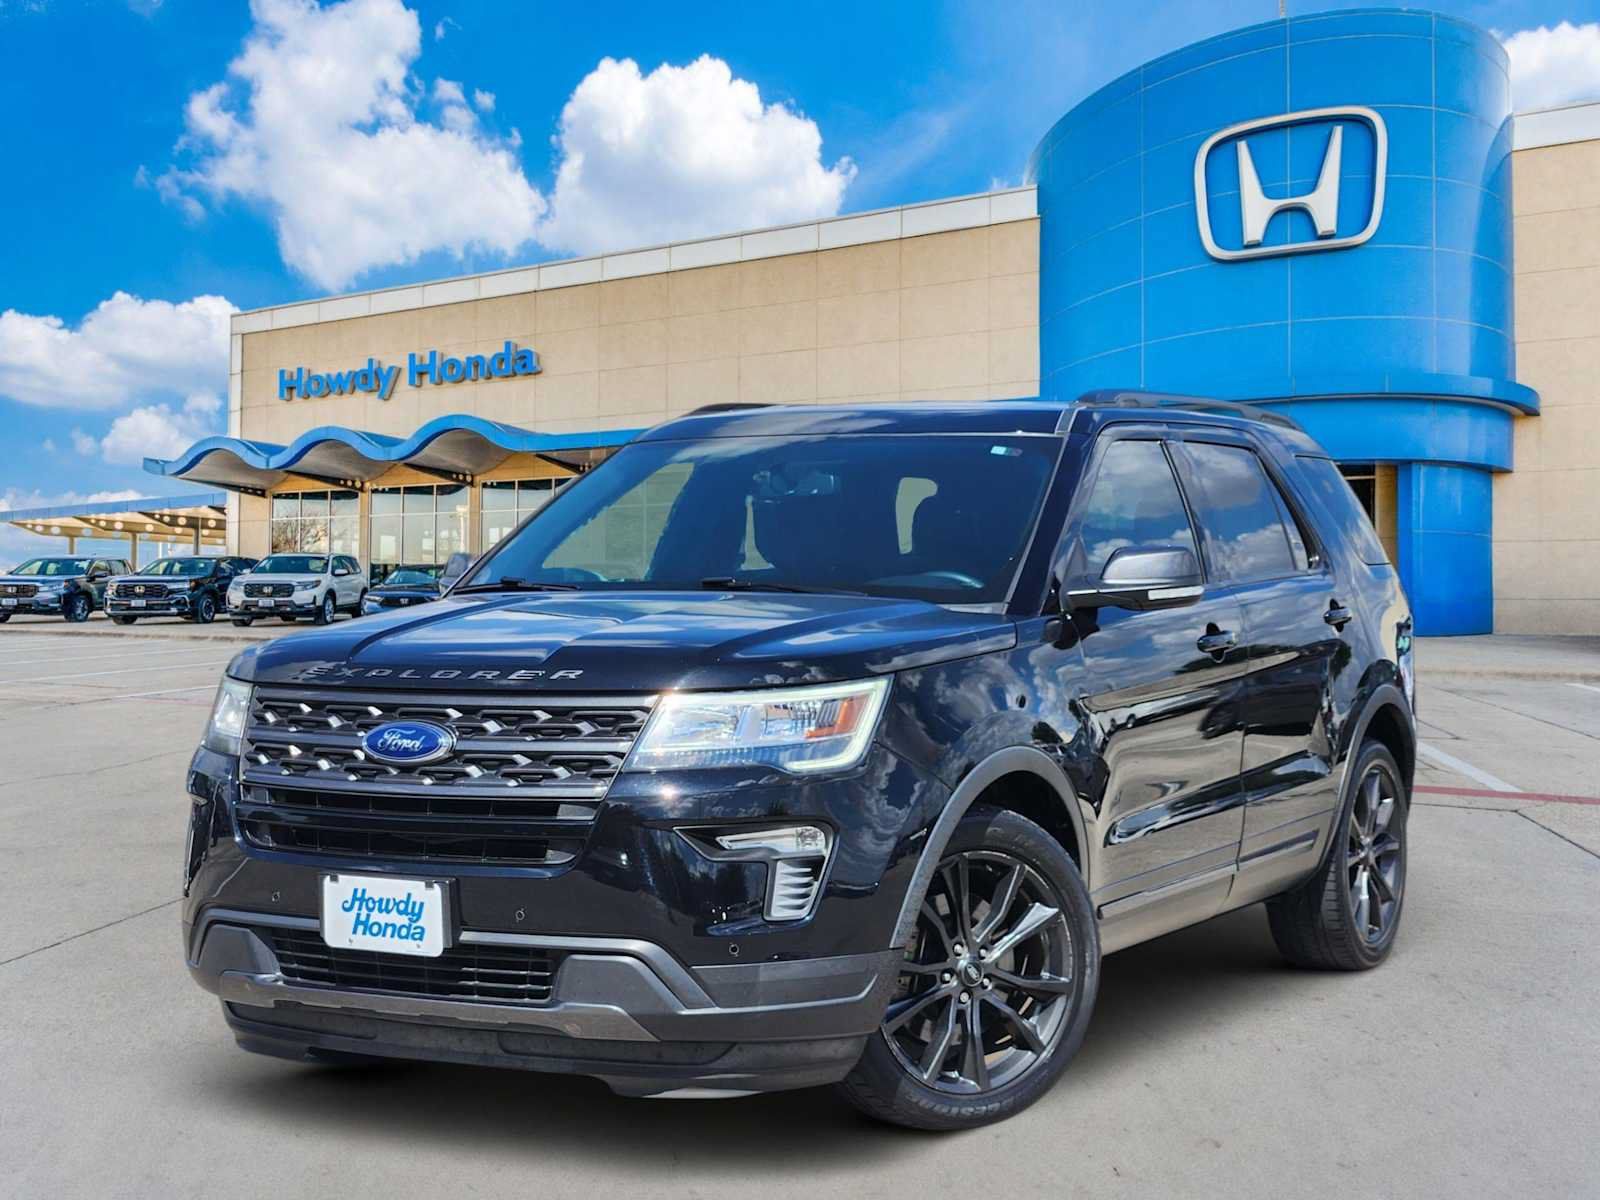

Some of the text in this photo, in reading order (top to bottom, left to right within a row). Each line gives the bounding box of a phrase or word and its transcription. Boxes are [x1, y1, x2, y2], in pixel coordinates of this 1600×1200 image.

[278, 341, 541, 400] Howdy Honda
[300, 667, 584, 681] EXPLORER
[377, 728, 426, 752] Ford
[341, 888, 425, 923] Howdy
[352, 913, 426, 942] Honda
